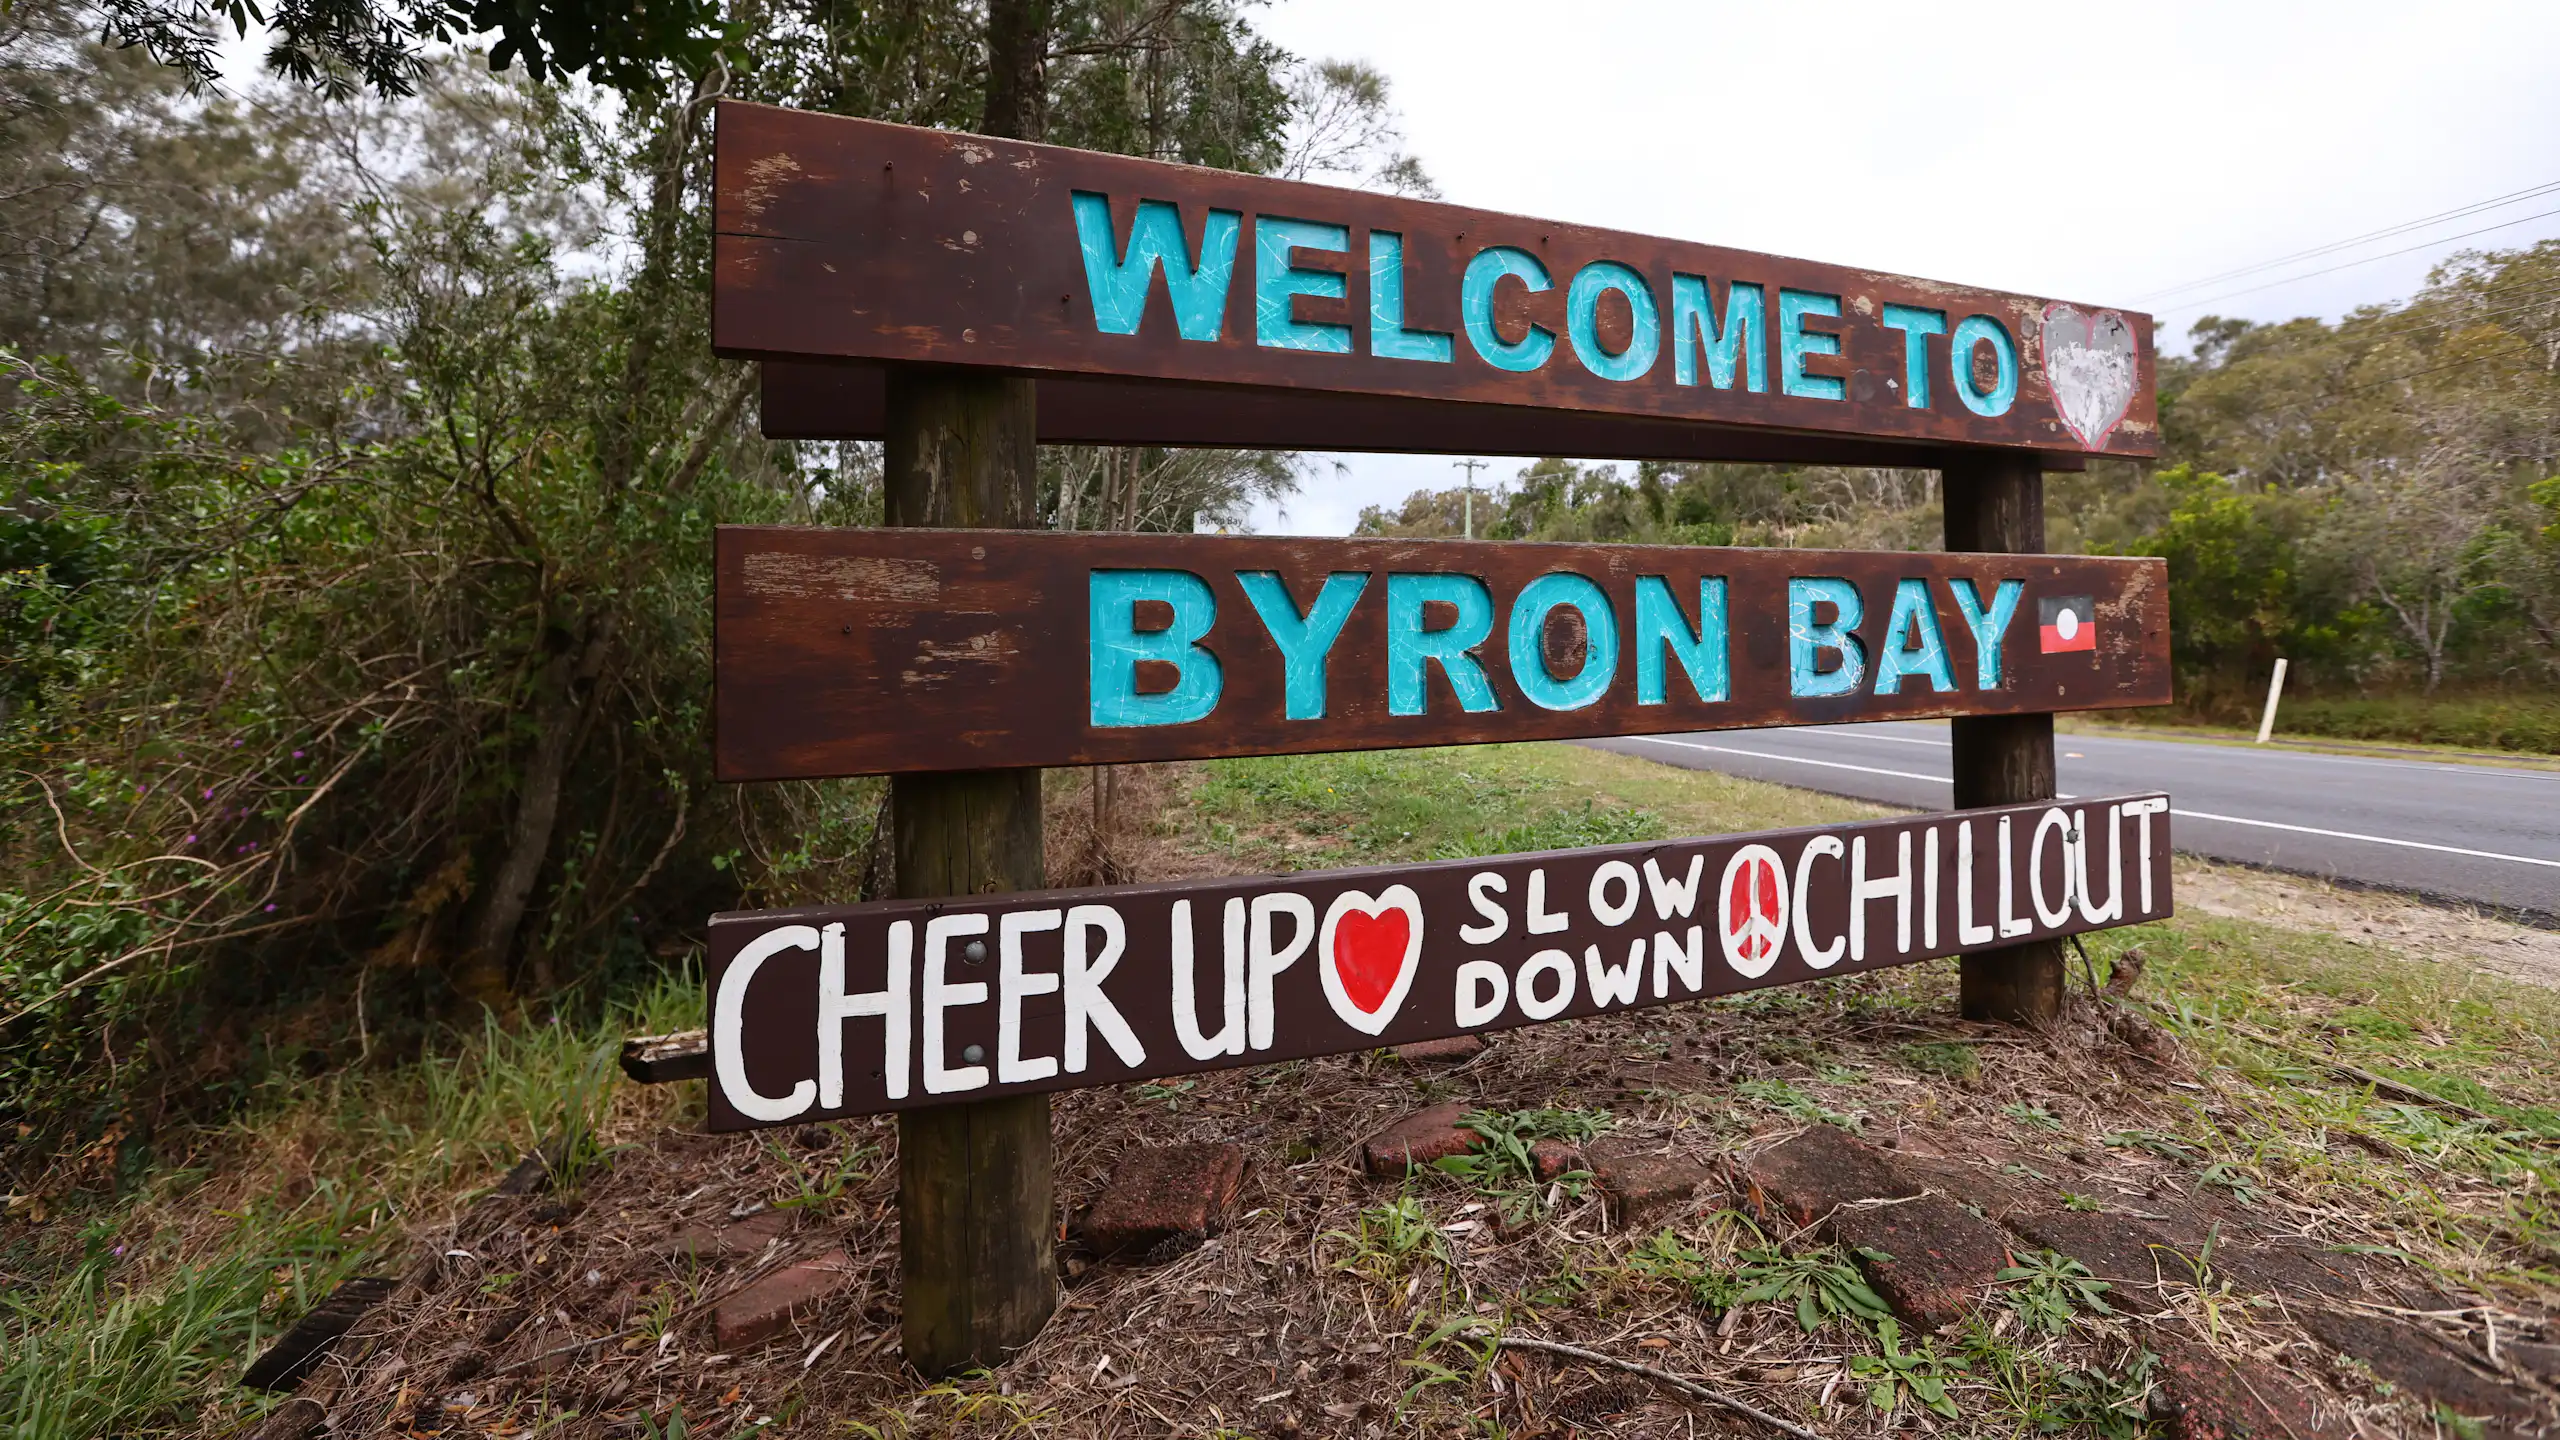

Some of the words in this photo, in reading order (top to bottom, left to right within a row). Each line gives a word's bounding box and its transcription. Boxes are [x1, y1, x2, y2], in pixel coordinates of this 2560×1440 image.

[1071, 190, 1848, 401] WELCOME
[1881, 302, 2020, 417] TO
[1227, 516, 1243, 527] Bay
[1088, 568, 1732, 728] BYRON
[1787, 575, 2026, 698] BAY
[1458, 854, 1704, 945] SLOW
[713, 904, 1147, 1122] CHEER
[1171, 892, 1316, 1061] UP
[1455, 925, 1703, 1028] DOWN
